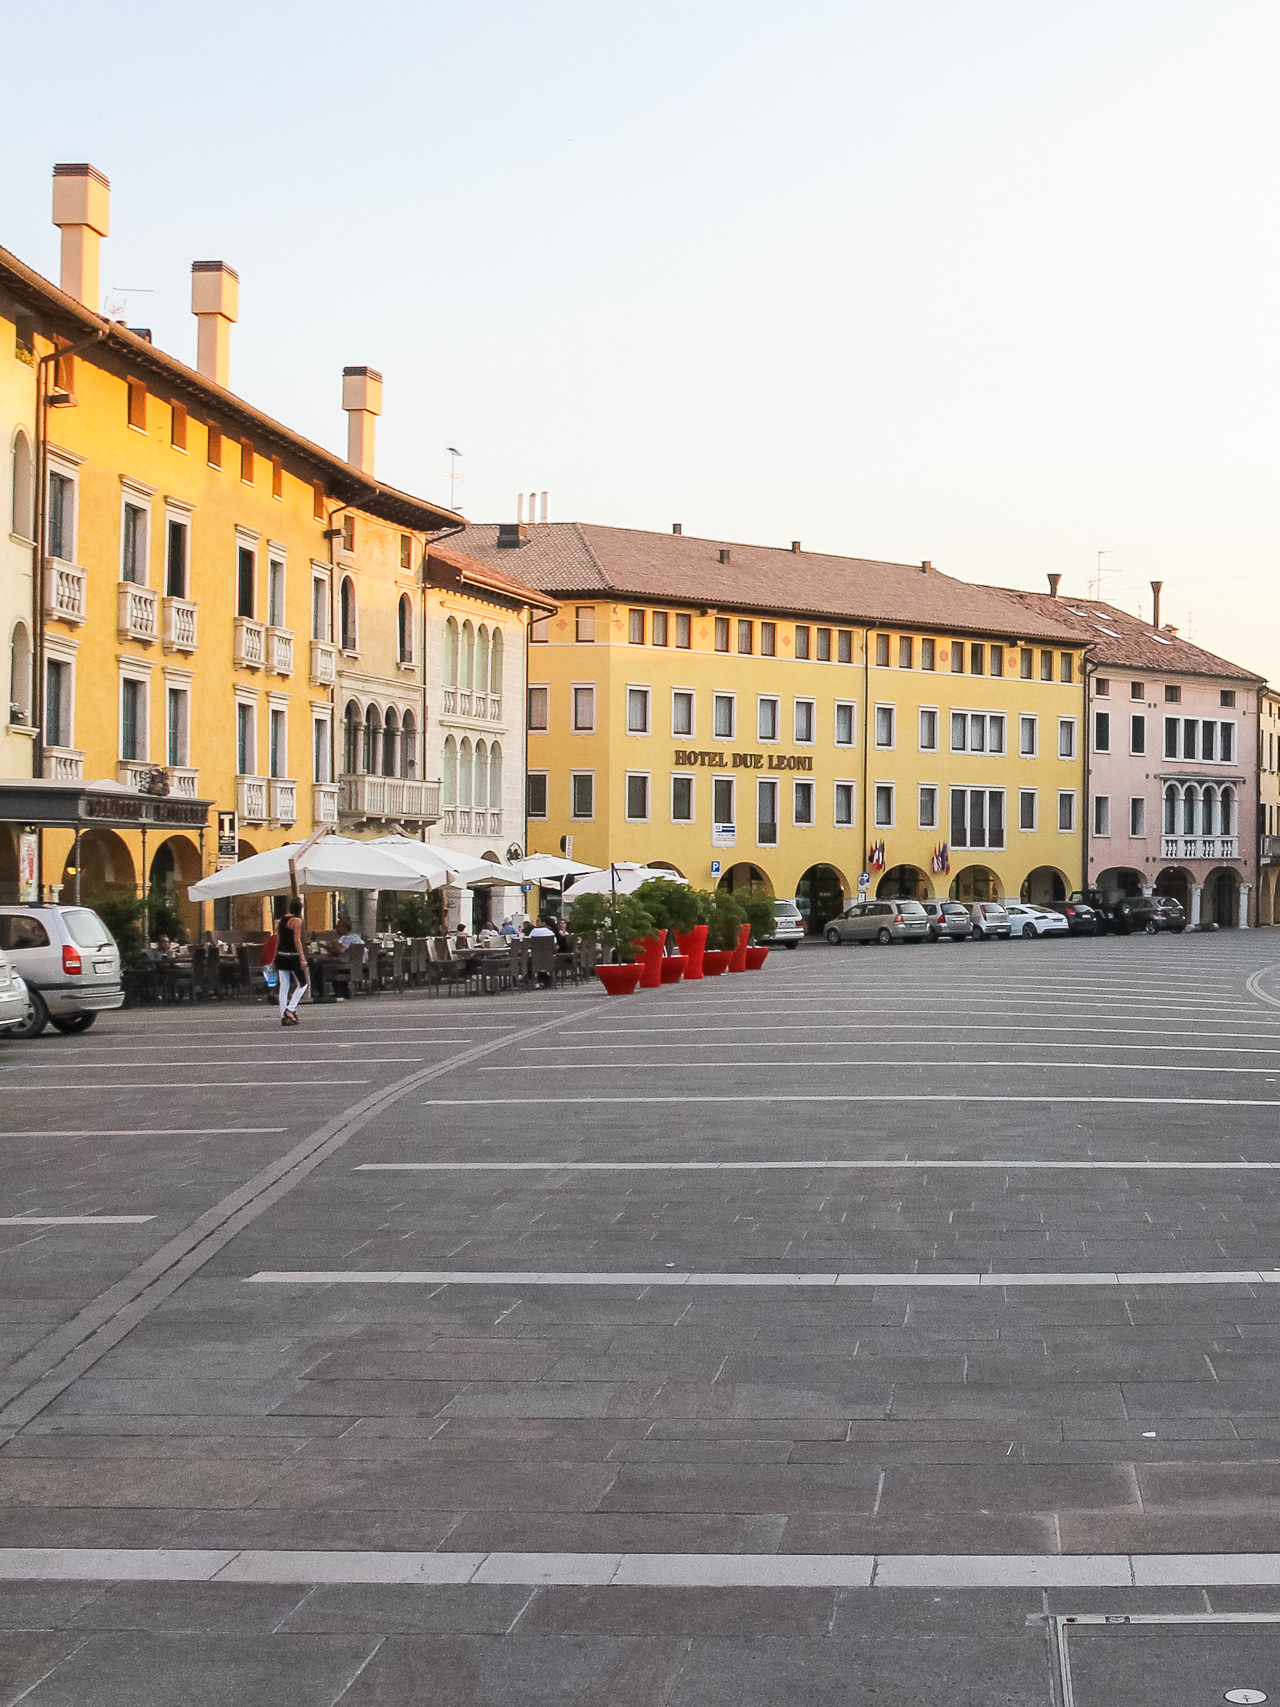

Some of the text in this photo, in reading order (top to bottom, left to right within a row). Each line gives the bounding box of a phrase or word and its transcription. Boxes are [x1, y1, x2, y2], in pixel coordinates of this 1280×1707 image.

[674, 750, 814, 771] HOTEL DUE LEONI
[712, 862, 719, 871] P
